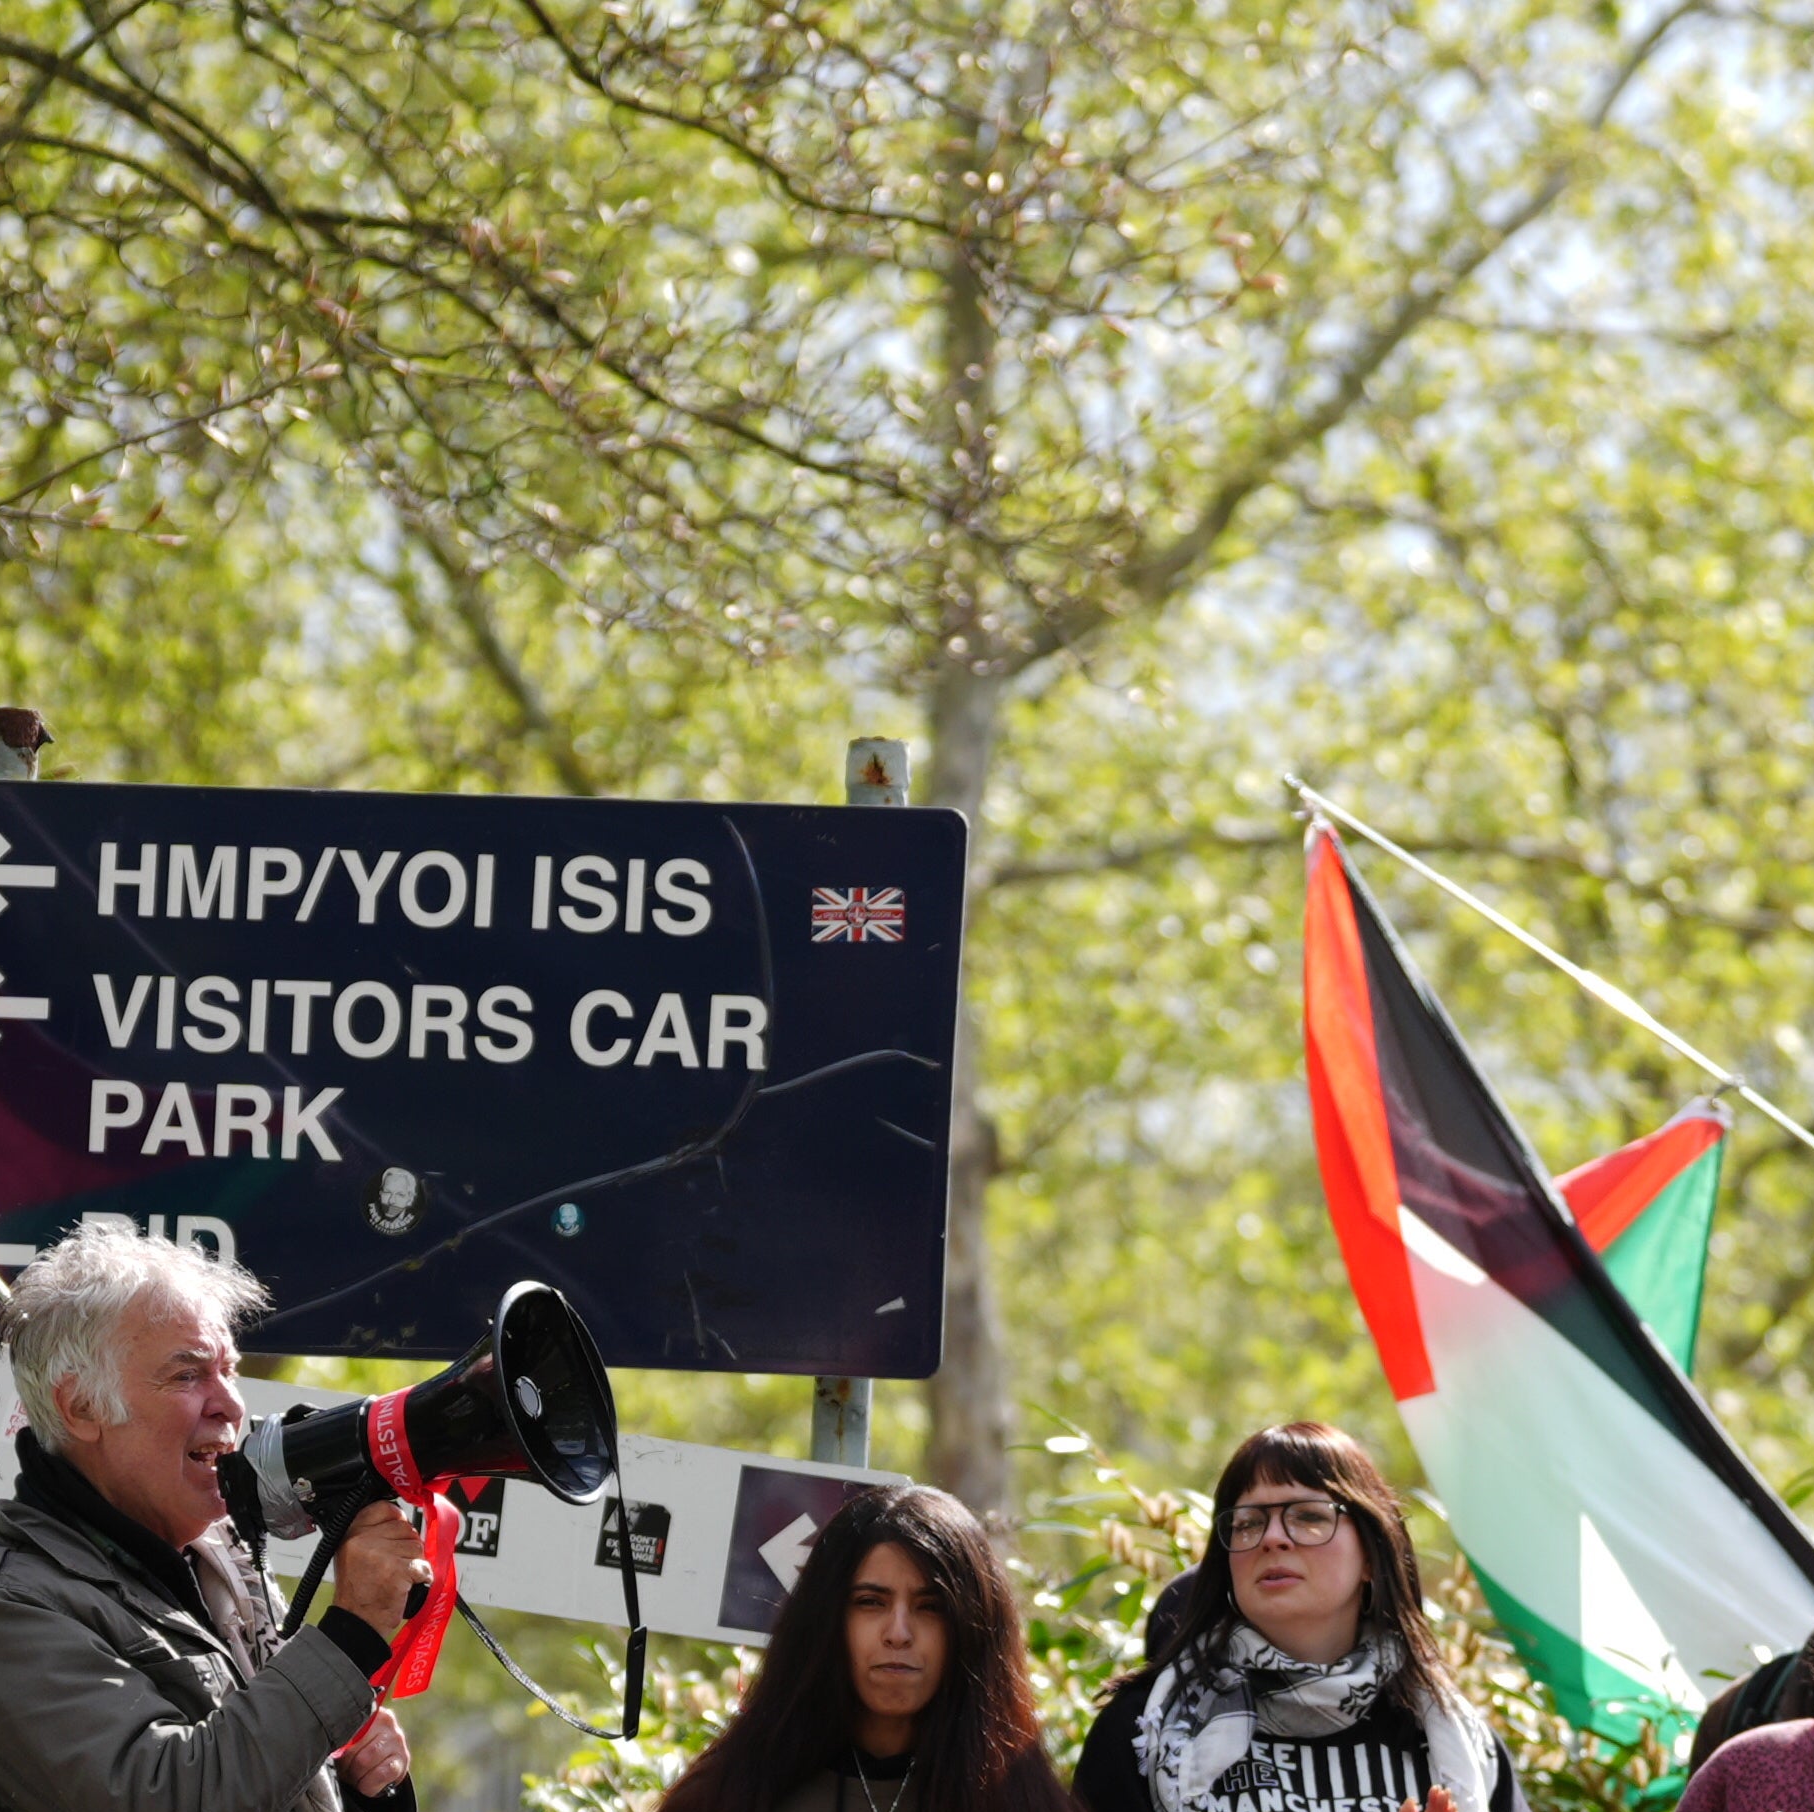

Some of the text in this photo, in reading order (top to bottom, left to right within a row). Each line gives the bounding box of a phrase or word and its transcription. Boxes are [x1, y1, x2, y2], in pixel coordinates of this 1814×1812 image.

[97, 842, 712, 936] HMP/YOI ISIS
[92, 973, 769, 1070] VISITORS CAR
[88, 1078, 345, 1161] PARK
[1221, 1761, 1279, 1793] HE
